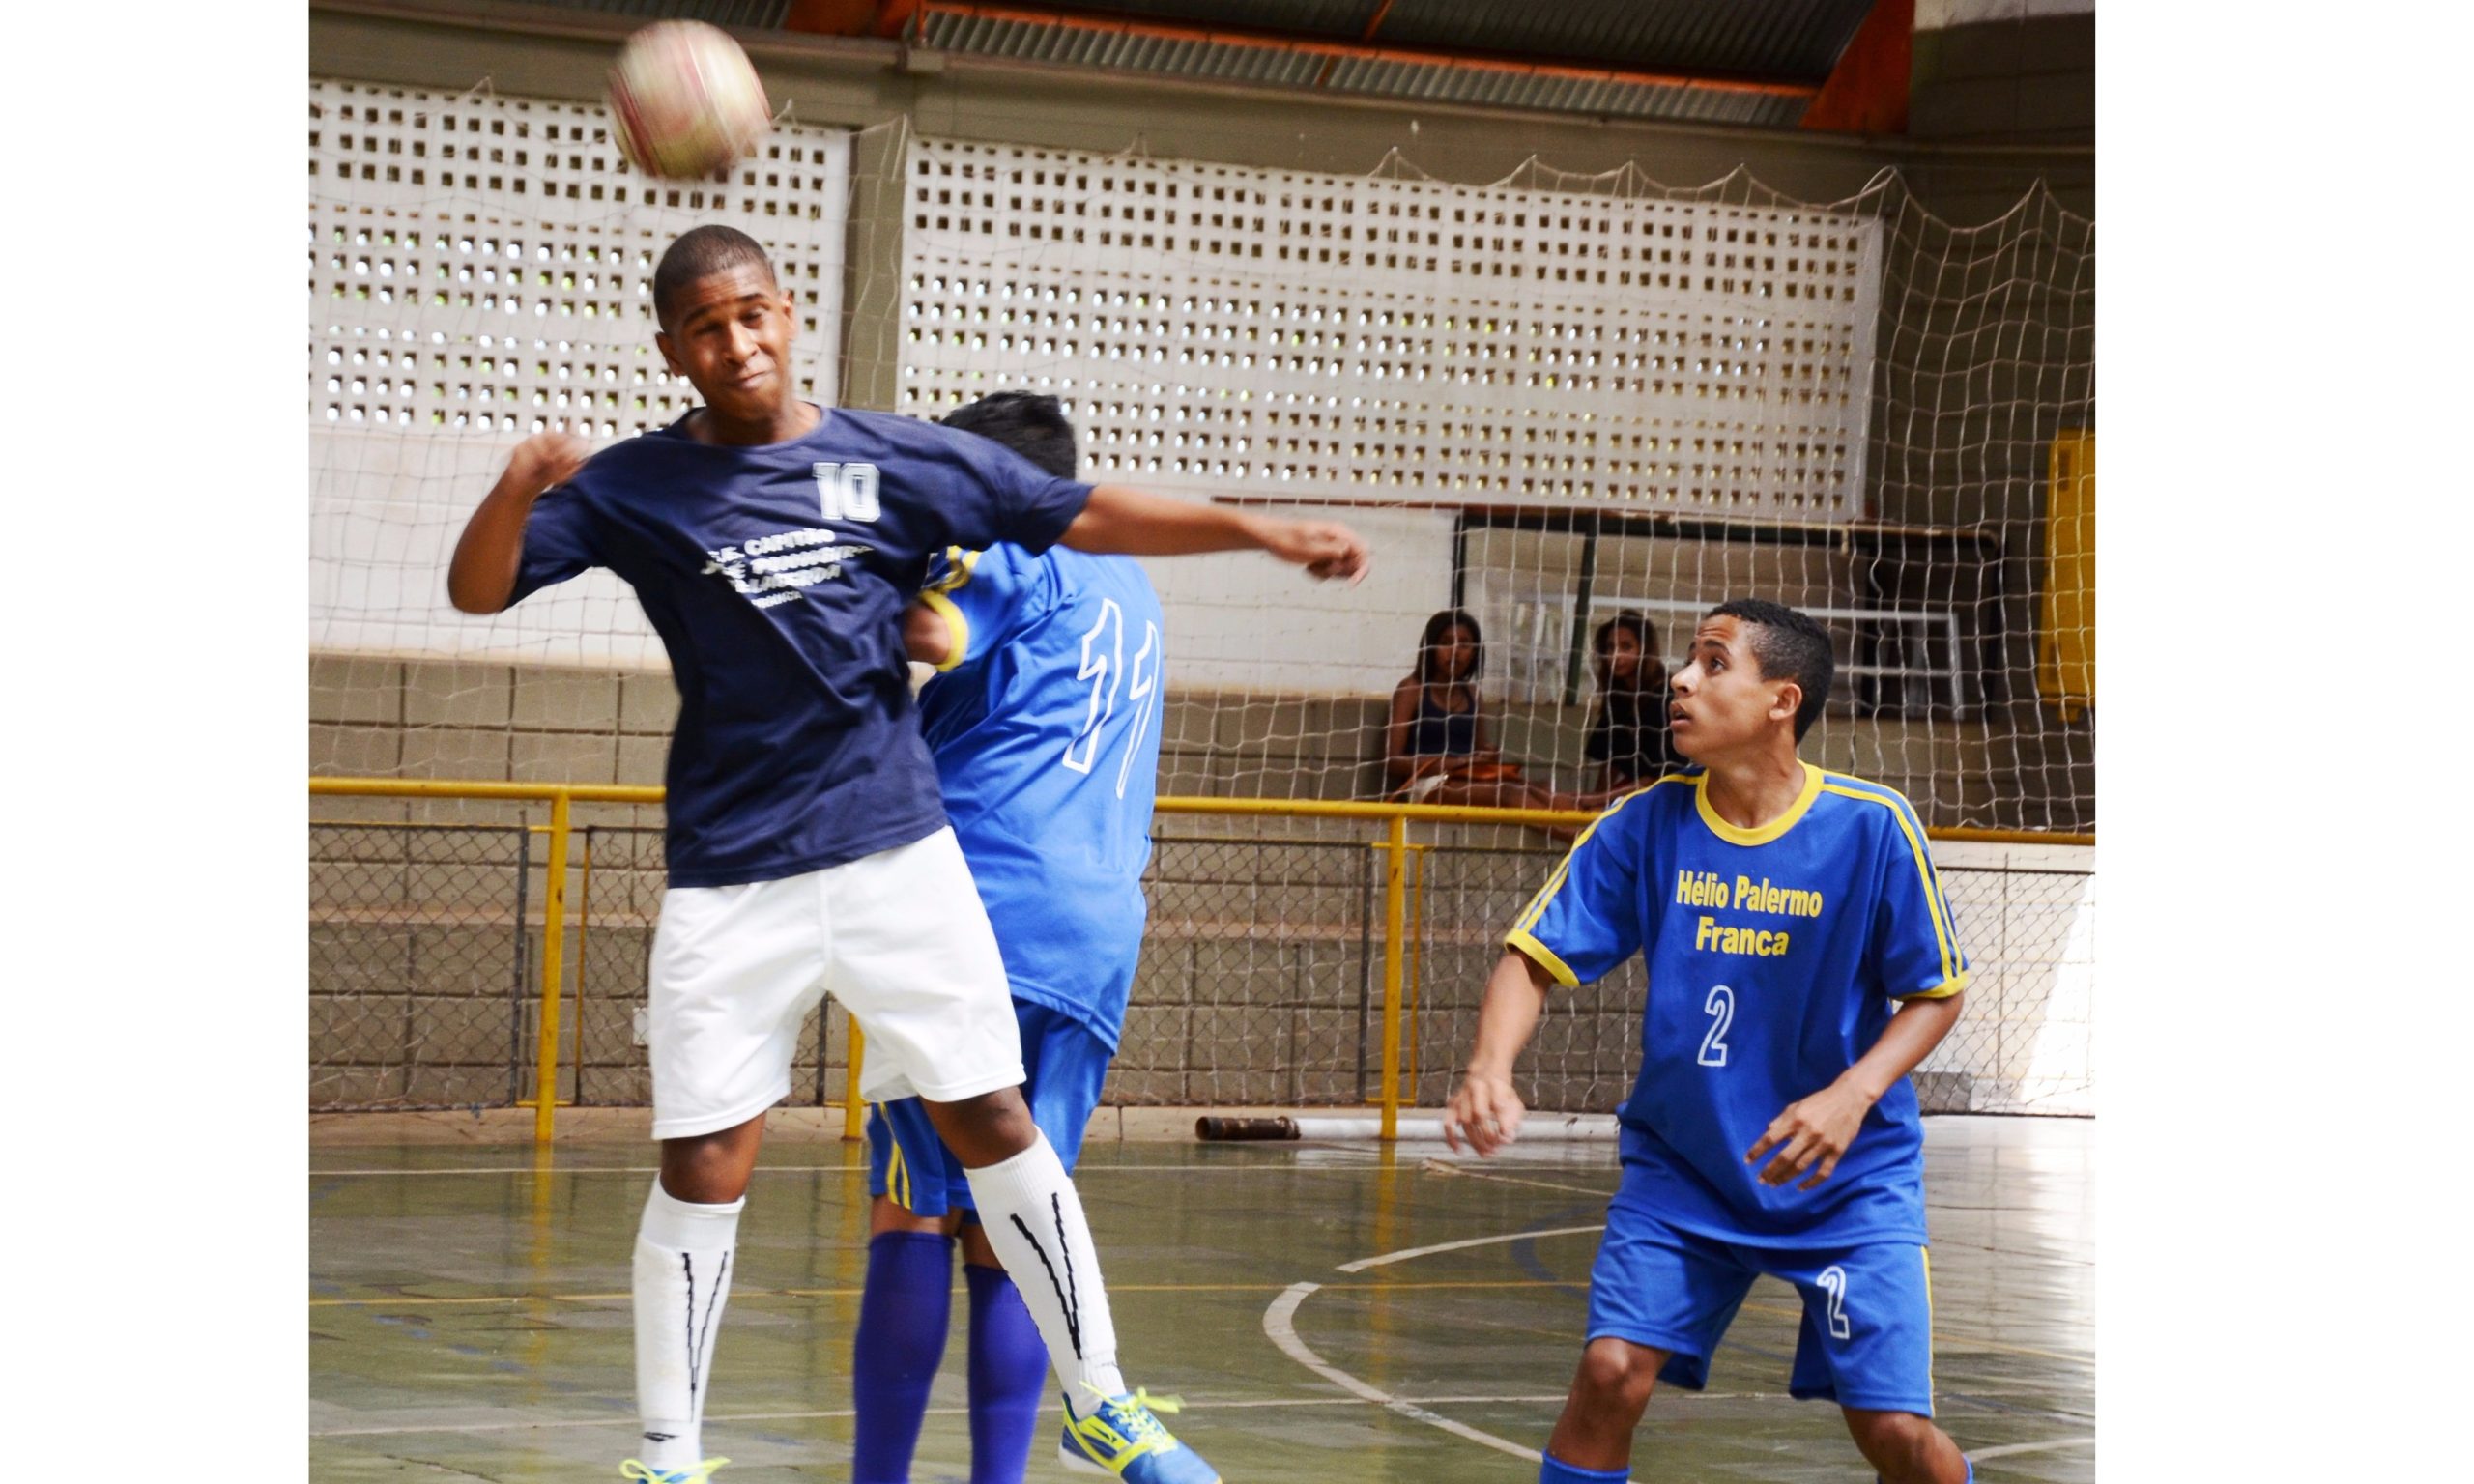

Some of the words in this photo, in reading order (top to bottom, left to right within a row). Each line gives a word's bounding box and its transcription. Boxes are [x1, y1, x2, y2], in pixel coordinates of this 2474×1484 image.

[812, 461, 882, 523] 10
[1676, 870, 1730, 908] Hélio
[1733, 875, 1824, 918] Palermo
[1695, 916, 1791, 956] Franca
[1697, 985, 1736, 1067] 2
[1816, 1265, 1851, 1340] 2
